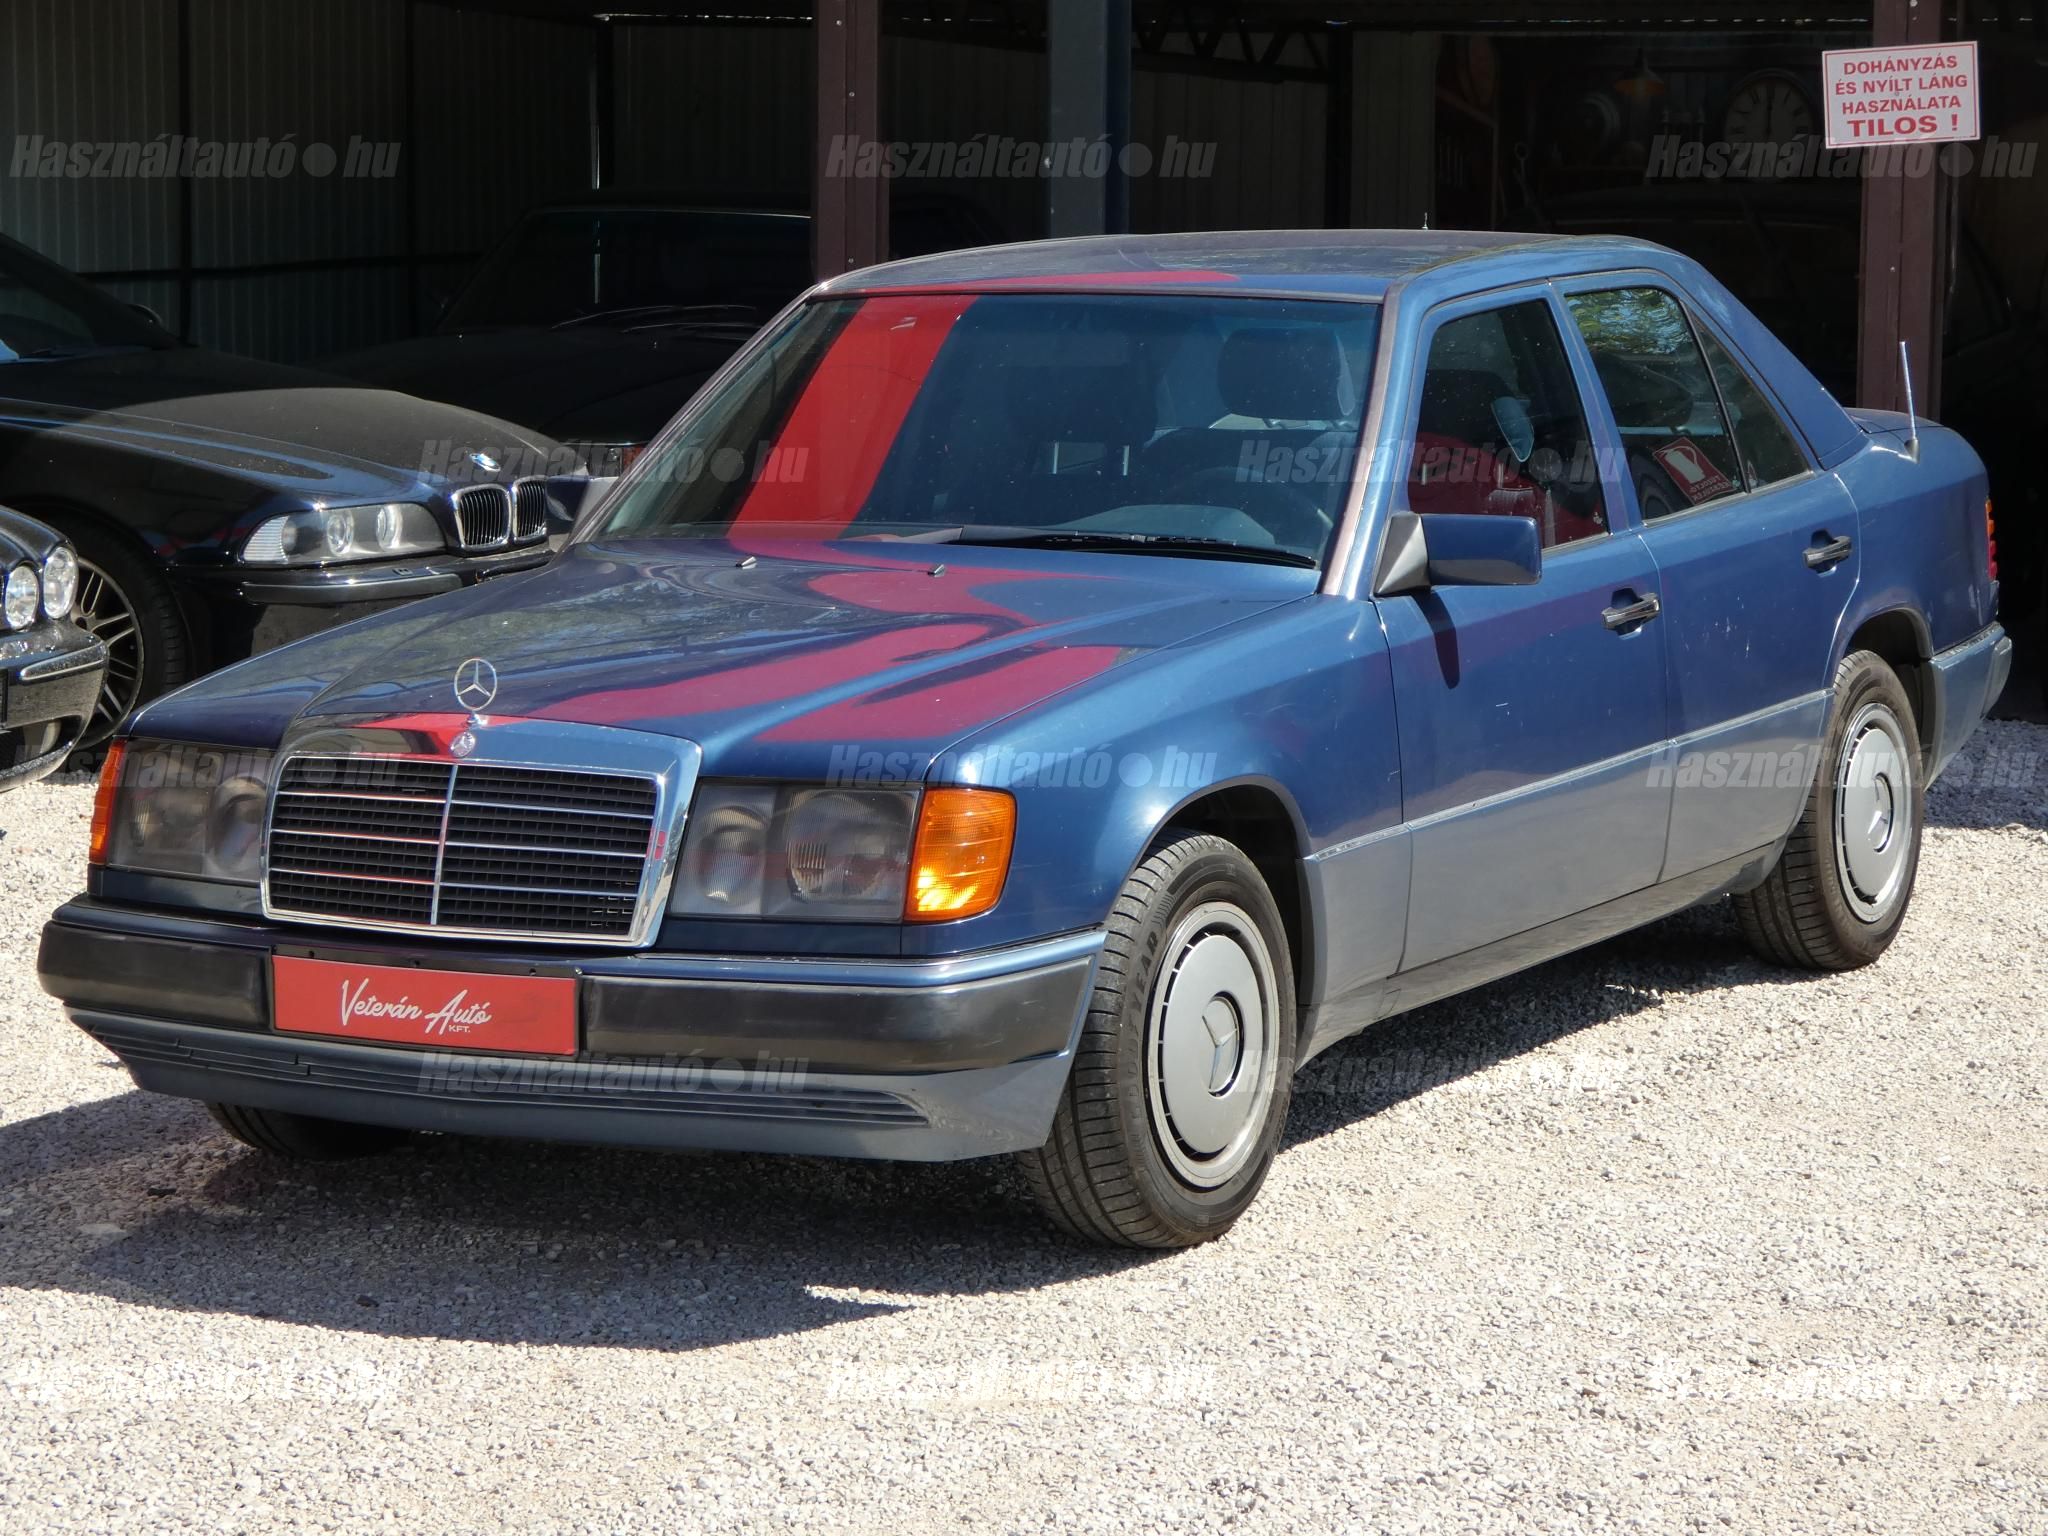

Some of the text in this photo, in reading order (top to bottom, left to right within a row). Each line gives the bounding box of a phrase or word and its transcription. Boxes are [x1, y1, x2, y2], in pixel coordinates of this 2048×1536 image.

[1843, 52, 1958, 75] DOHÁNYZÁS
[1835, 72, 1968, 95] ÉS NYÍLT LÁNG
[1842, 95, 1961, 115] HASZNÁLATA
[1847, 115, 1938, 137] TILOS
[341, 978, 493, 1035] Veterán Autó
[448, 1024, 471, 1033] KFT.
